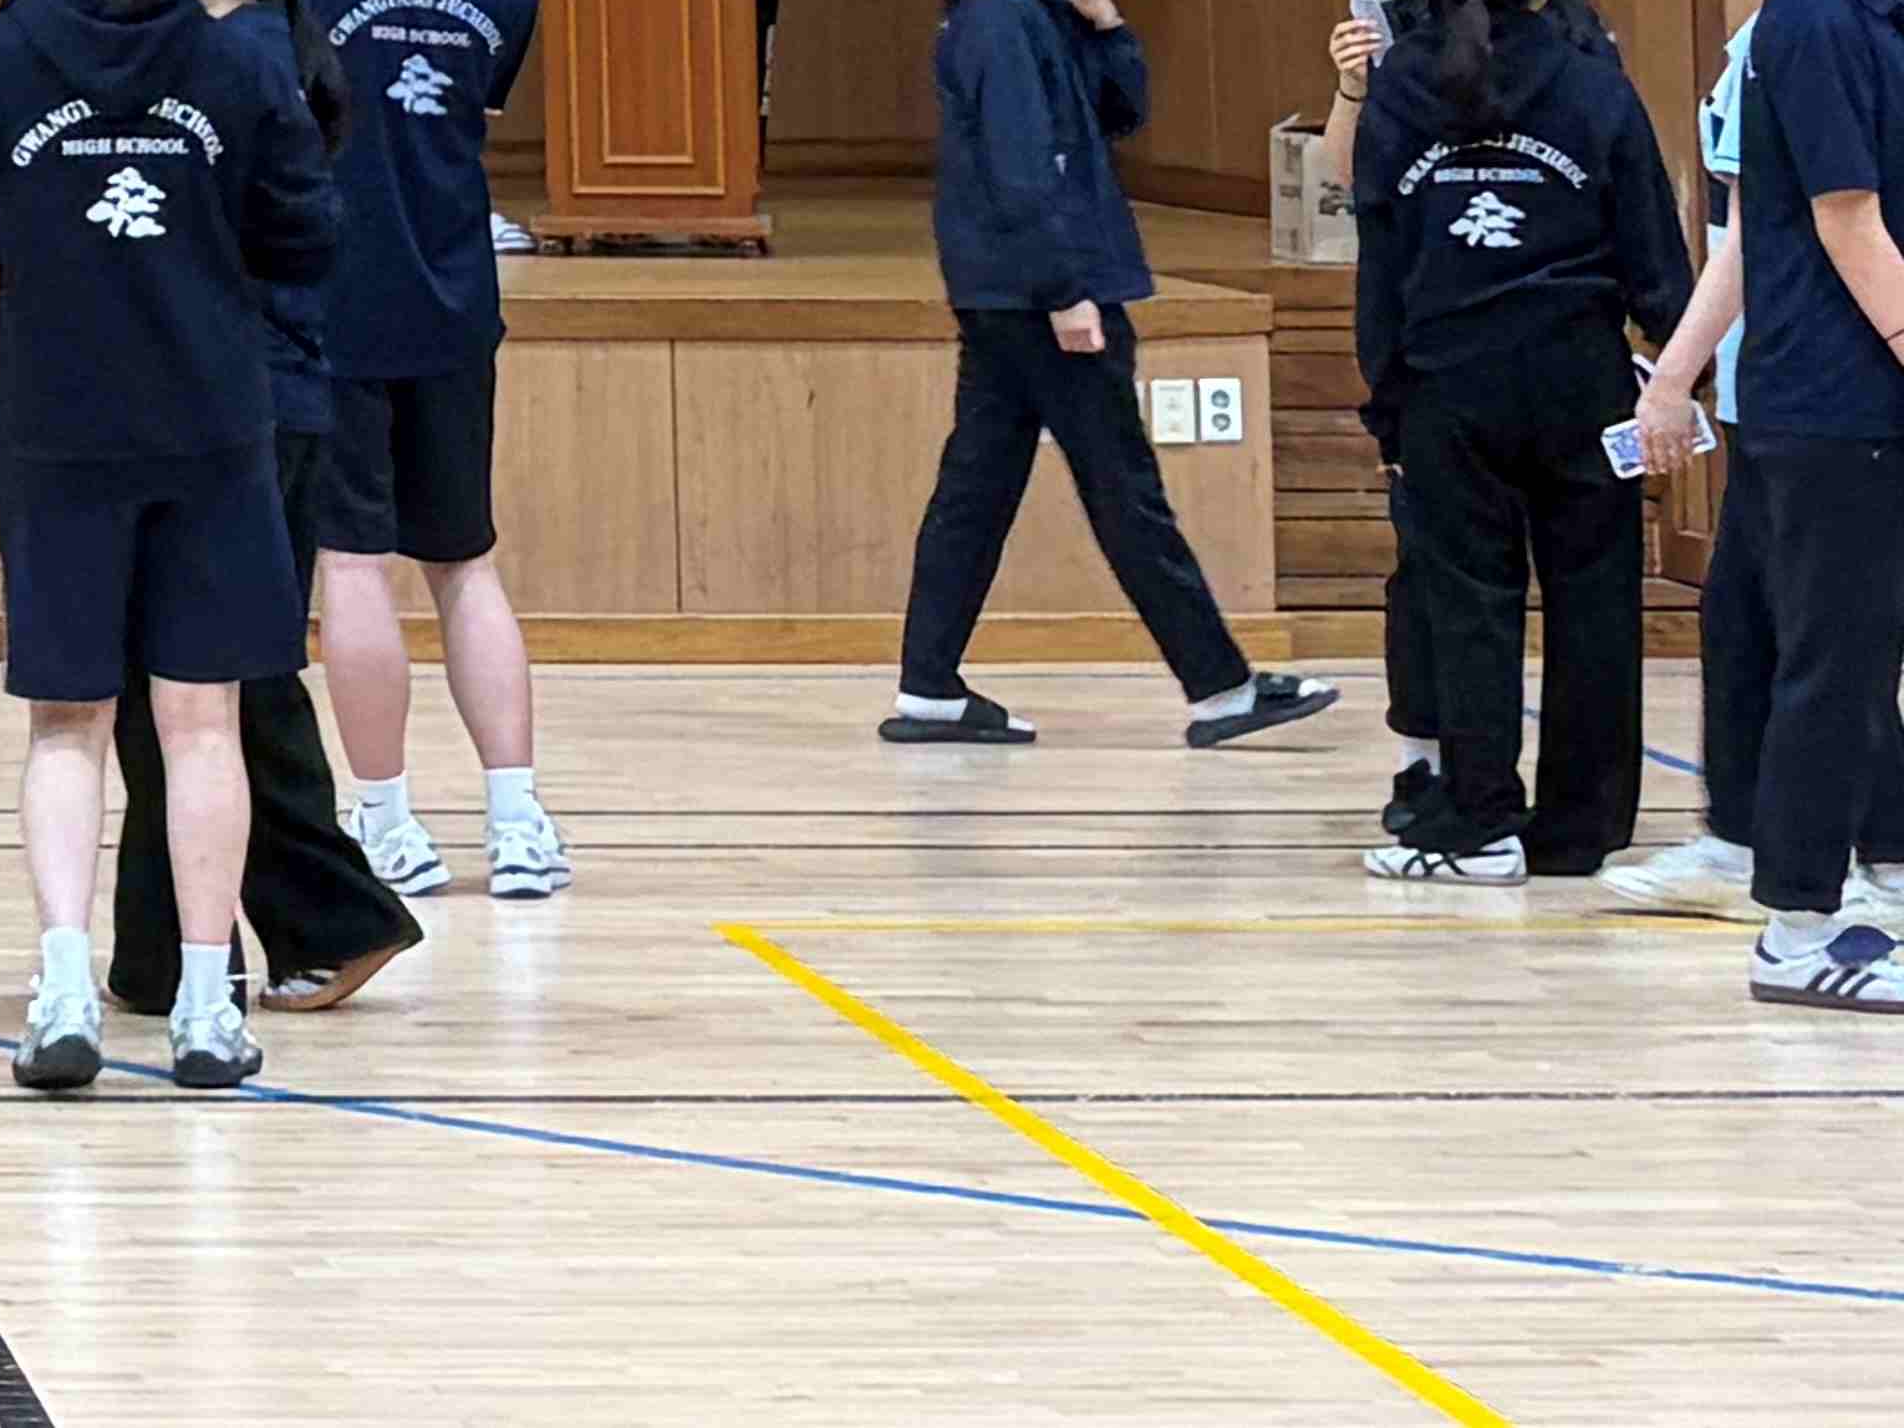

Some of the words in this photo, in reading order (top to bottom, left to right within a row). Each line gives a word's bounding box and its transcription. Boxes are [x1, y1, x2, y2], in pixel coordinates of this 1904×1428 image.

[61, 137, 113, 157] HIGH
[114, 135, 190, 156] SCHOOL
[146, 96, 224, 168] ECHEOL
